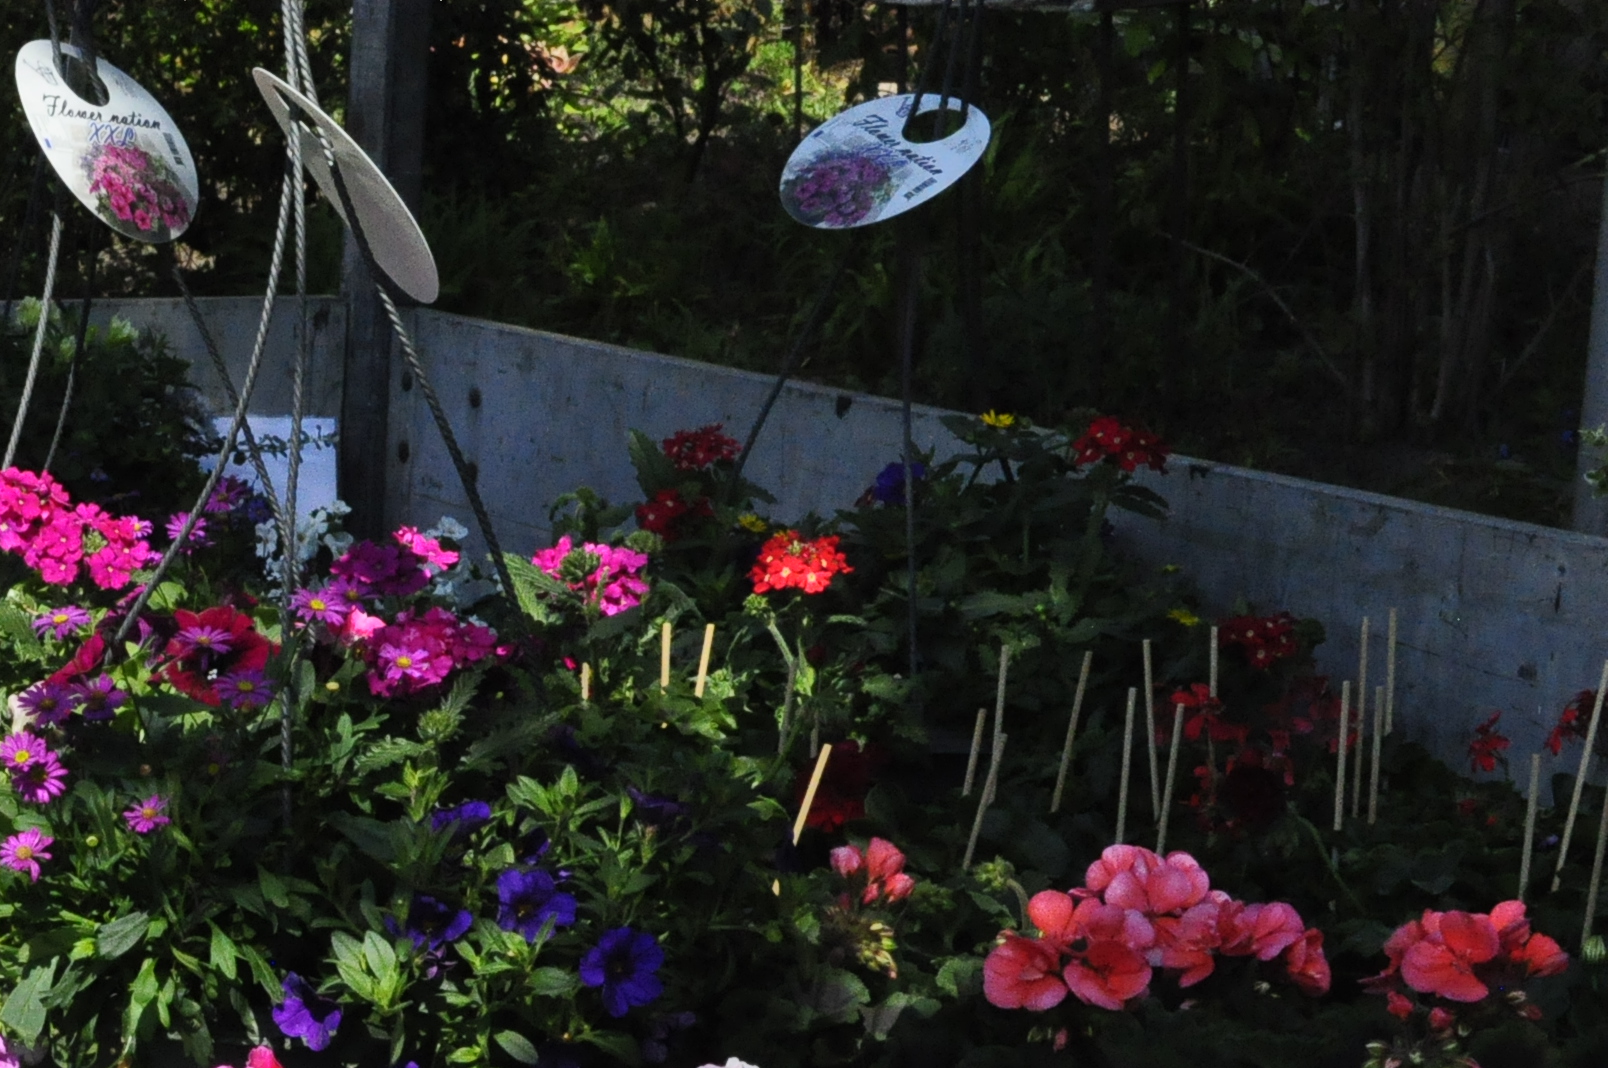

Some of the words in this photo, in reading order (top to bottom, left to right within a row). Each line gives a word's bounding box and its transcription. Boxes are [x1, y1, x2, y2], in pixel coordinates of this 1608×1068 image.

[42, 93, 103, 122] Flower
[108, 111, 161, 131] nation
[88, 121, 136, 147] XXL
[852, 113, 901, 148] Flower
[899, 147, 943, 176] nation
